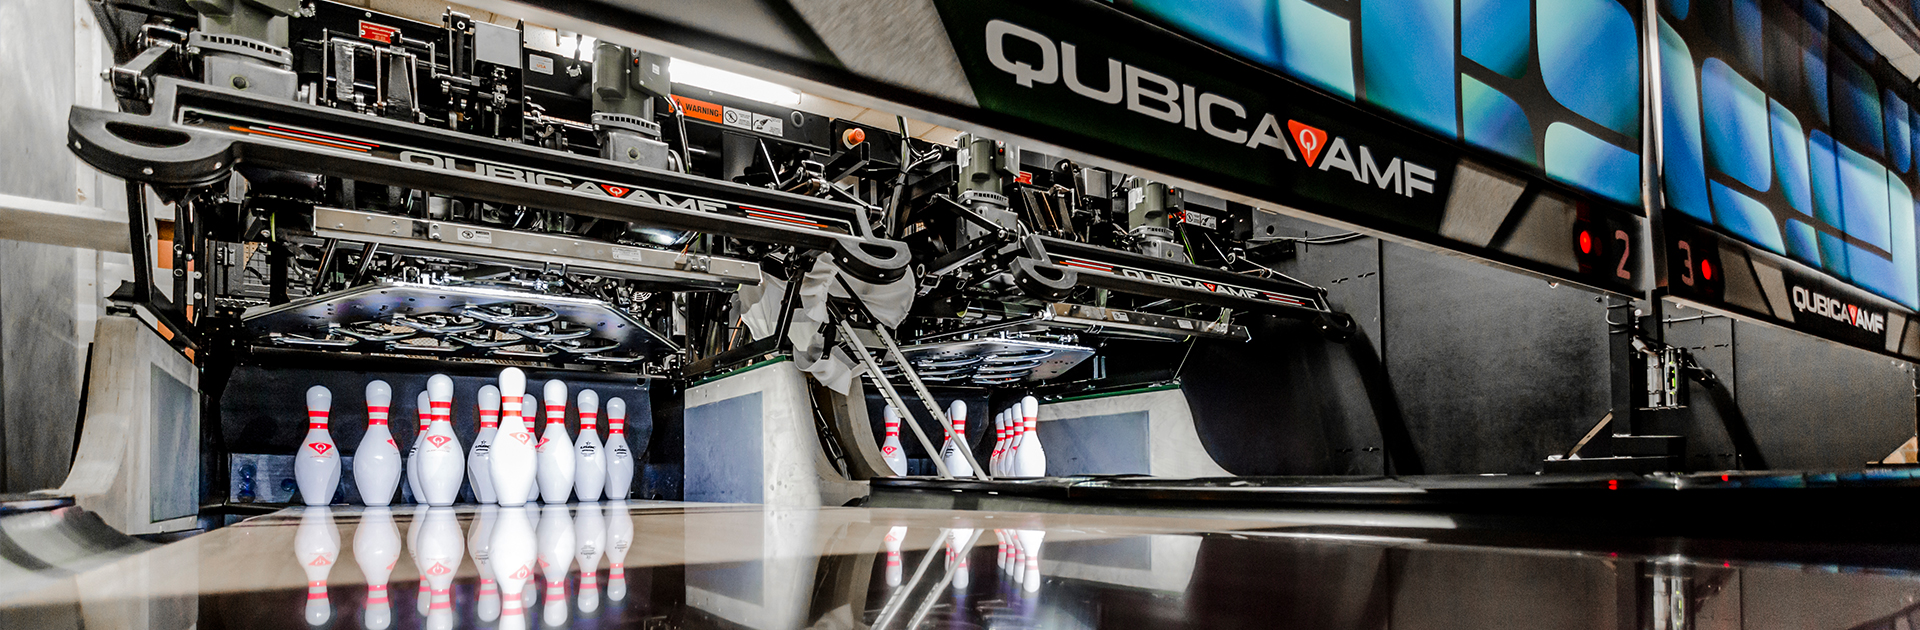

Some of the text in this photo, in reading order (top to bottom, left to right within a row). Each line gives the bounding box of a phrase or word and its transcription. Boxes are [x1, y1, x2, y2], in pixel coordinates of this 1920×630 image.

[985, 19, 1297, 162] QUBICA
[1319, 136, 1437, 198] AMF
[400, 150, 605, 195] QUBICA
[623, 189, 727, 213] AMF
[1615, 229, 1631, 280] 2
[1678, 240, 1694, 286] 3
[1122, 268, 1209, 292] QUBICA
[1215, 284, 1259, 299] AMF
[1792, 285, 1884, 334] QUBICA AMF
